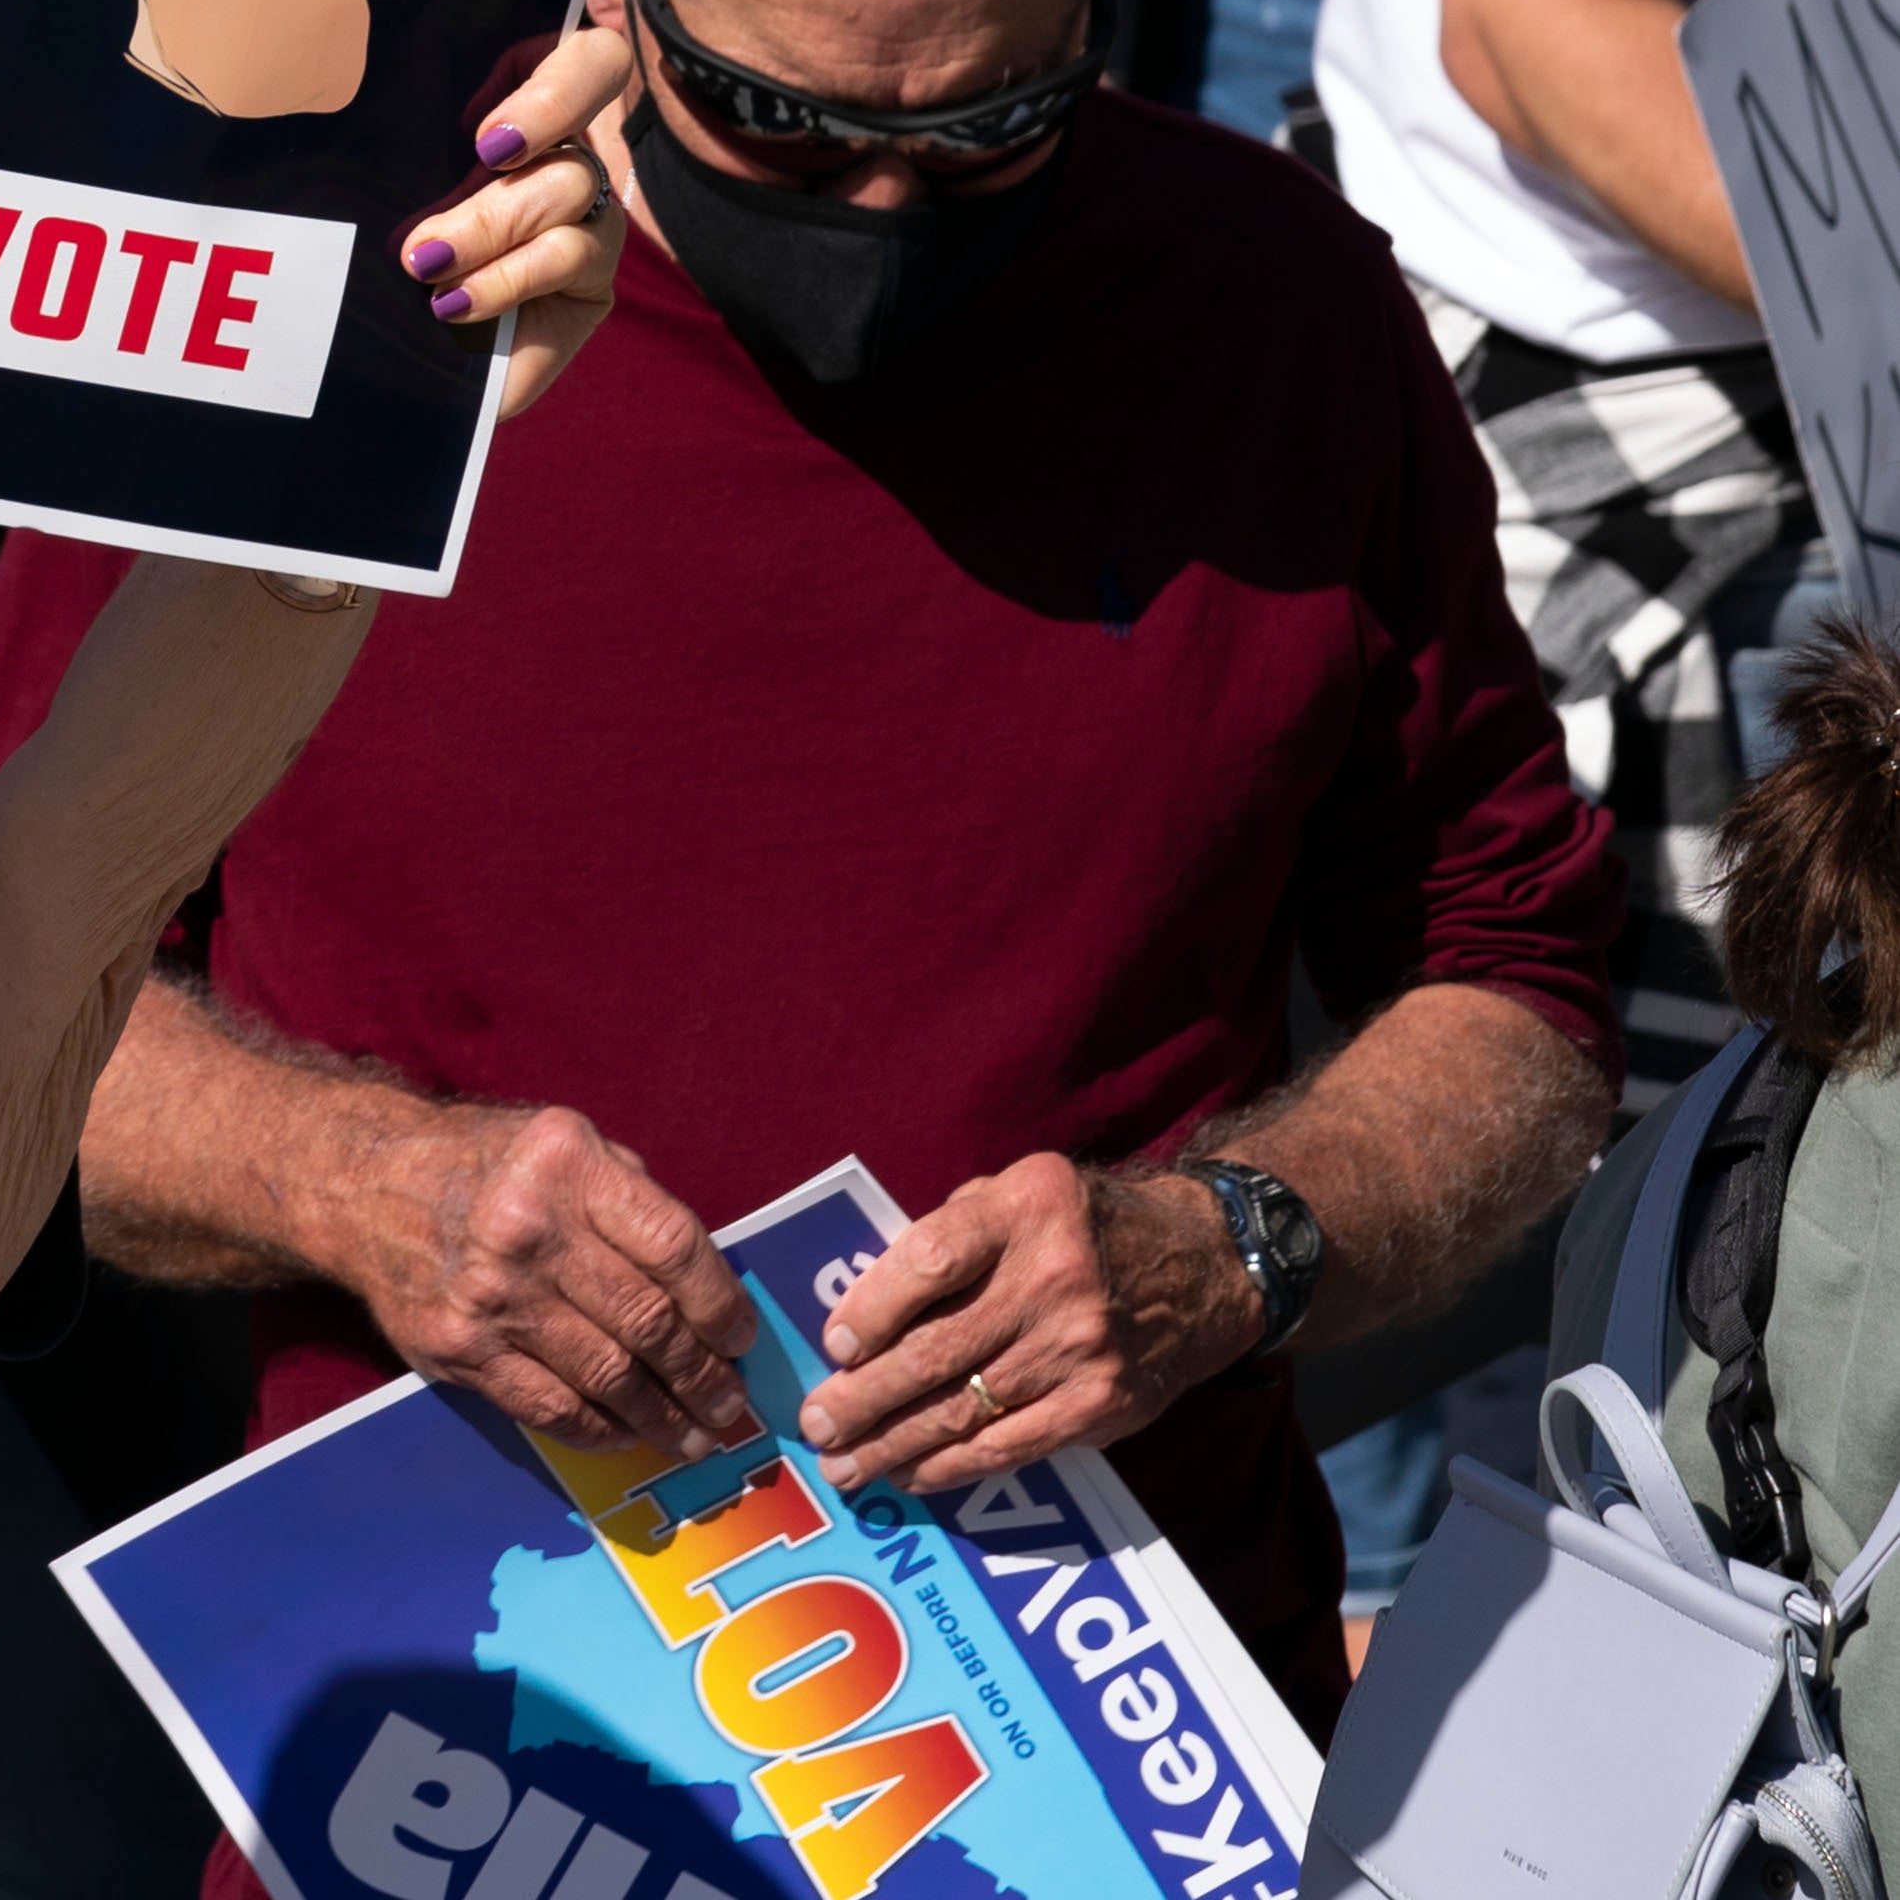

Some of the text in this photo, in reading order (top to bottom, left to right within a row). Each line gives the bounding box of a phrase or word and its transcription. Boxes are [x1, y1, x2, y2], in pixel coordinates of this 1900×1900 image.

[853, 1493, 1036, 1760] ON OR BEFORE NO
